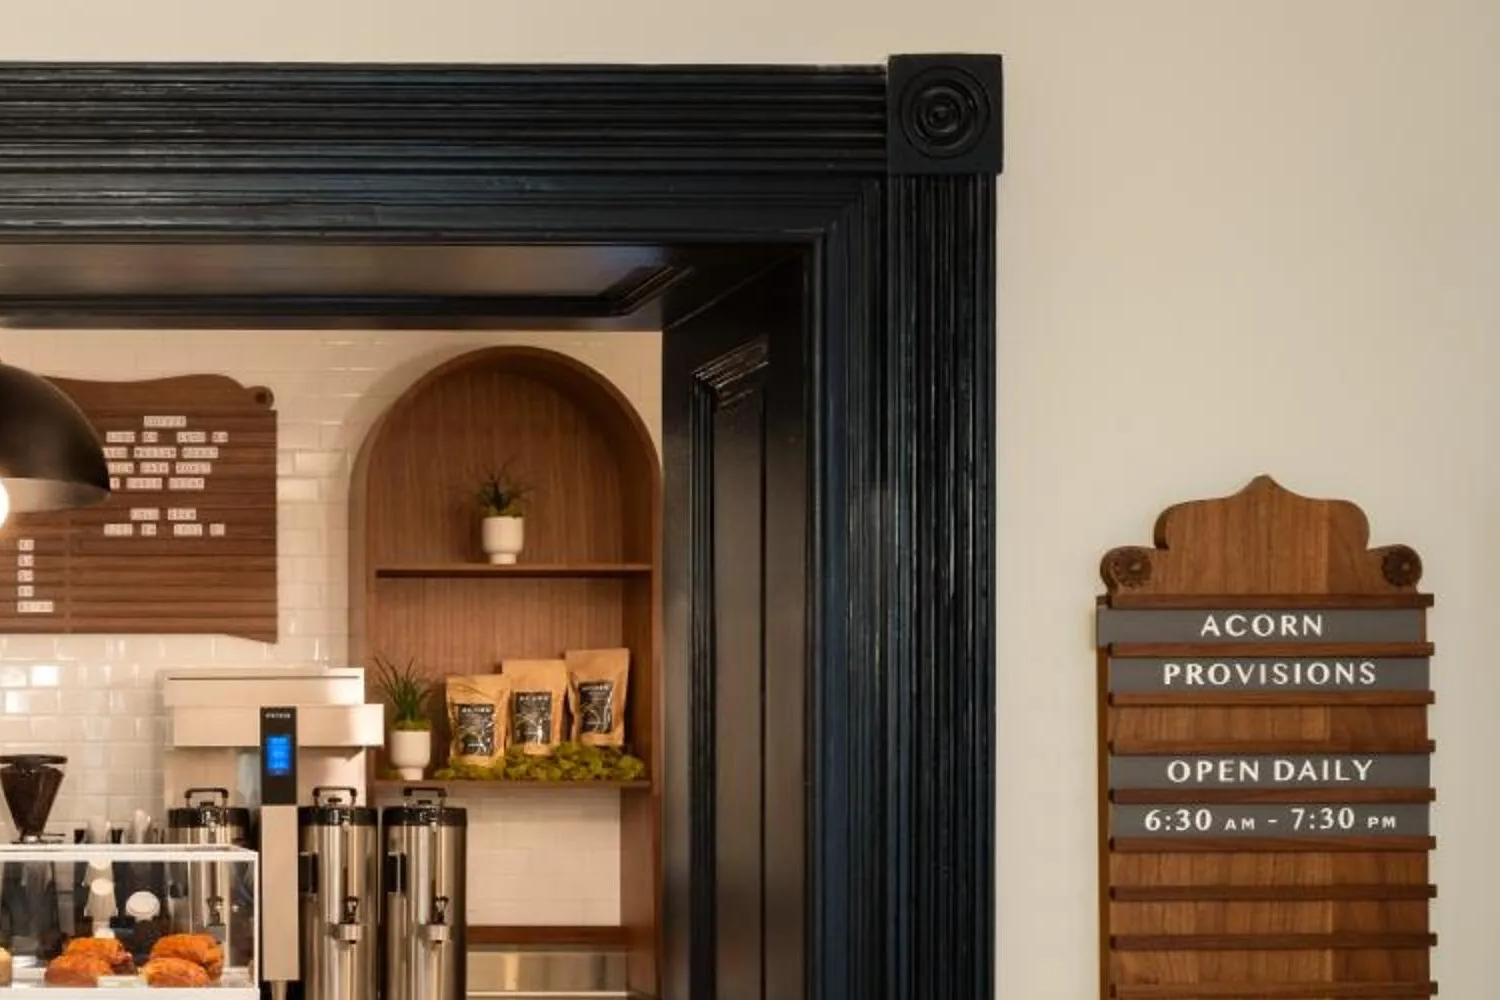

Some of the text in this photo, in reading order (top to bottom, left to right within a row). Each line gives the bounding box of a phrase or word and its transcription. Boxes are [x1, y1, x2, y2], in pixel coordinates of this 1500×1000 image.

[1200, 614, 1324, 638] ACORN
[1162, 662, 1377, 686] PROVISIONS
[1166, 758, 1373, 783] OPEN DAILY
[1144, 808, 1213, 831] 6:30
[1223, 816, 1256, 830] AM
[1290, 807, 1355, 831] 7:30
[1367, 815, 1397, 829] PM
